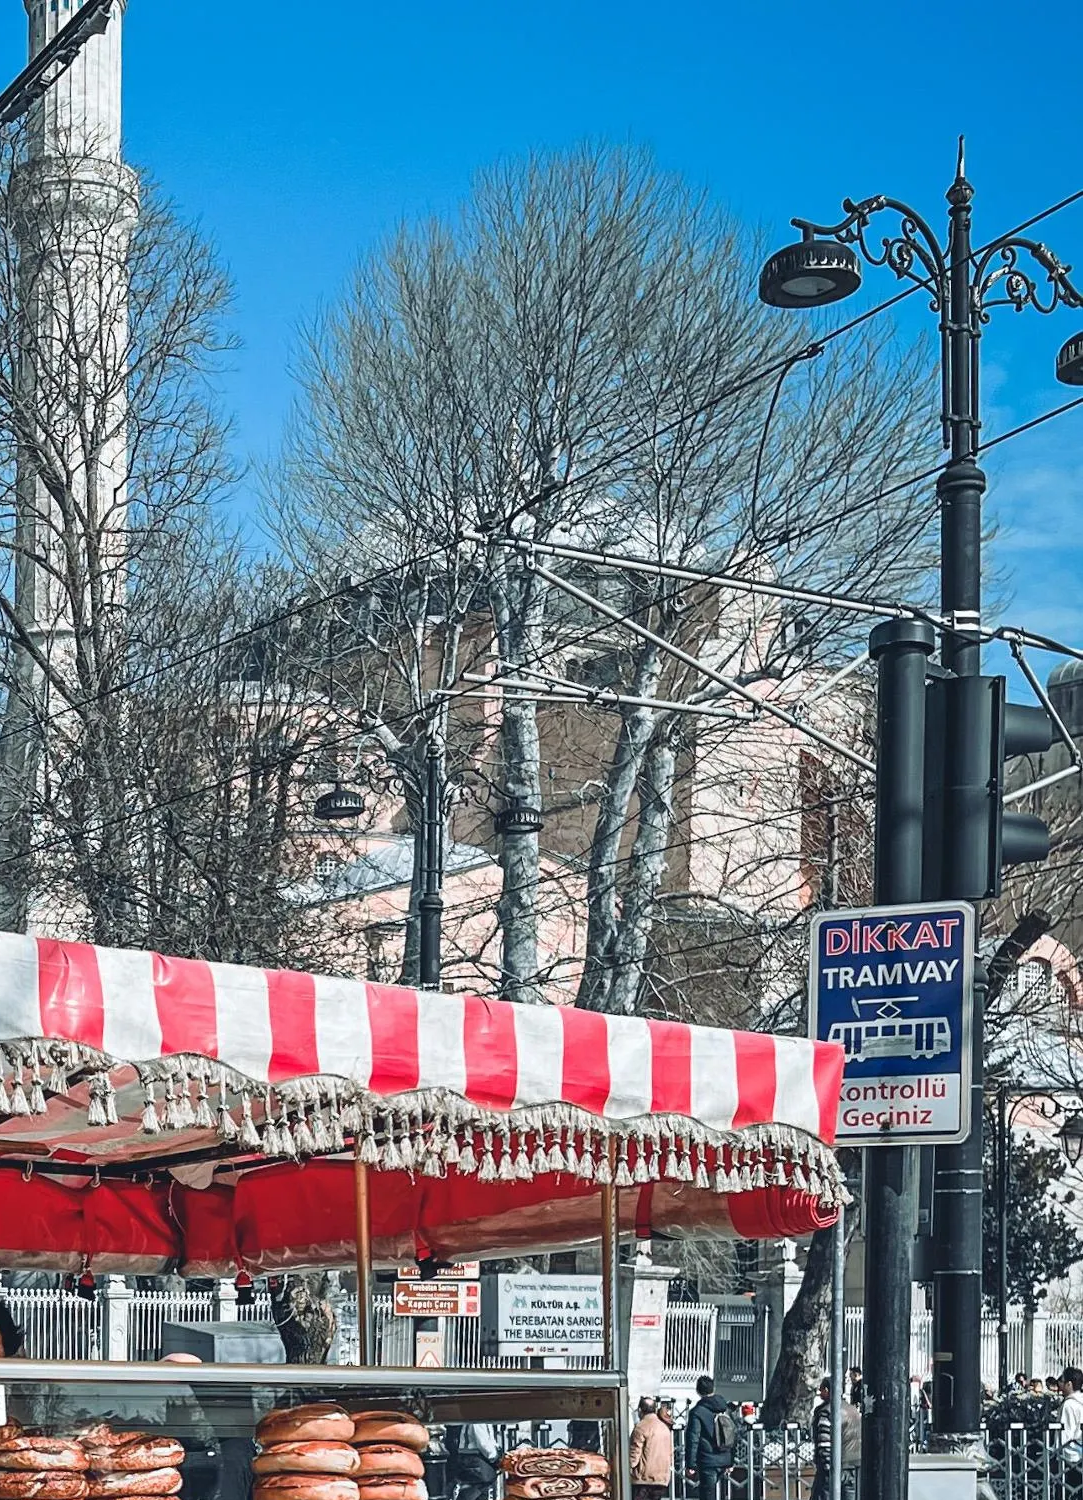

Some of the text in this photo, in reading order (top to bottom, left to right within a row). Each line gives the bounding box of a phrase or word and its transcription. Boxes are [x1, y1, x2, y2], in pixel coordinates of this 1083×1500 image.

[826, 918, 960, 957] DİKKAT
[822, 959, 960, 990] TRAMVAY
[531, 1299, 563, 1310] KÜLTÜR
[509, 1315, 564, 1327] YEREBATAN
[504, 1328, 604, 1340] THE BASILICA CISTER
